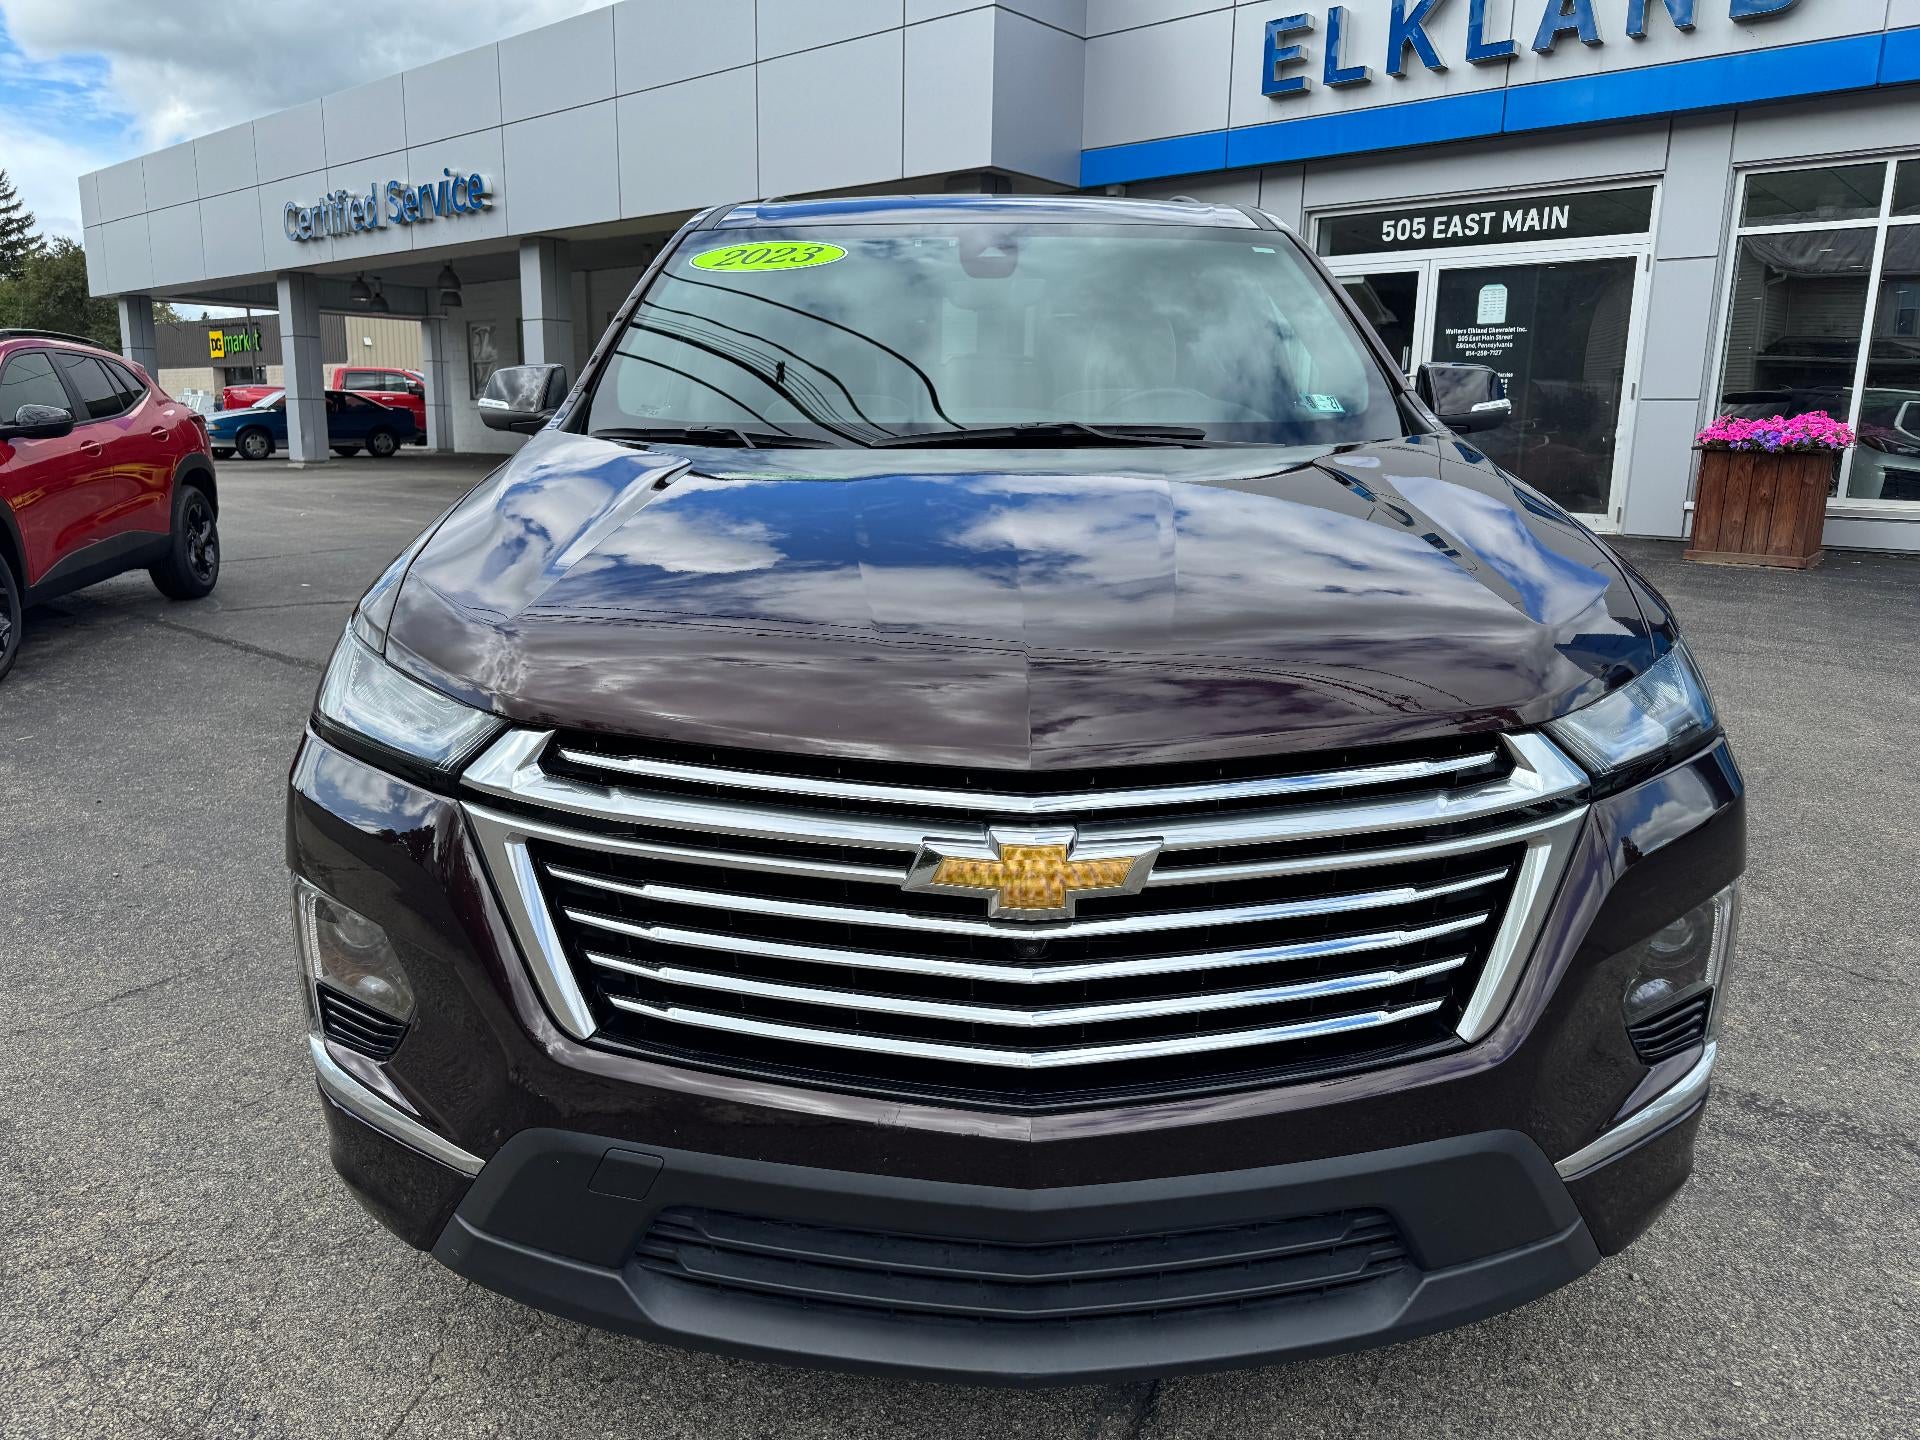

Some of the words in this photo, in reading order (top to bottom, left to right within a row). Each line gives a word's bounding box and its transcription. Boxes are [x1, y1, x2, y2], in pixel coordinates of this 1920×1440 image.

[1262, 0, 1800, 98] ELKLAN
[283, 182, 386, 242] Certified
[386, 167, 492, 225] Service
[1381, 217, 1426, 242] 505
[1432, 211, 1496, 239] EAST
[1502, 205, 1570, 234] MAIN
[712, 246, 824, 266] 2023
[211, 338, 222, 351] DG
[224, 328, 260, 352] markt
[1467, 327, 1488, 335] Elkland
[1488, 326, 1516, 334] Chevrolet
[1469, 334, 1482, 342] East
[1482, 334, 1495, 342] Main
[1456, 342, 1477, 350] Elkland,
[1477, 341, 1513, 350] Pennsylvania
